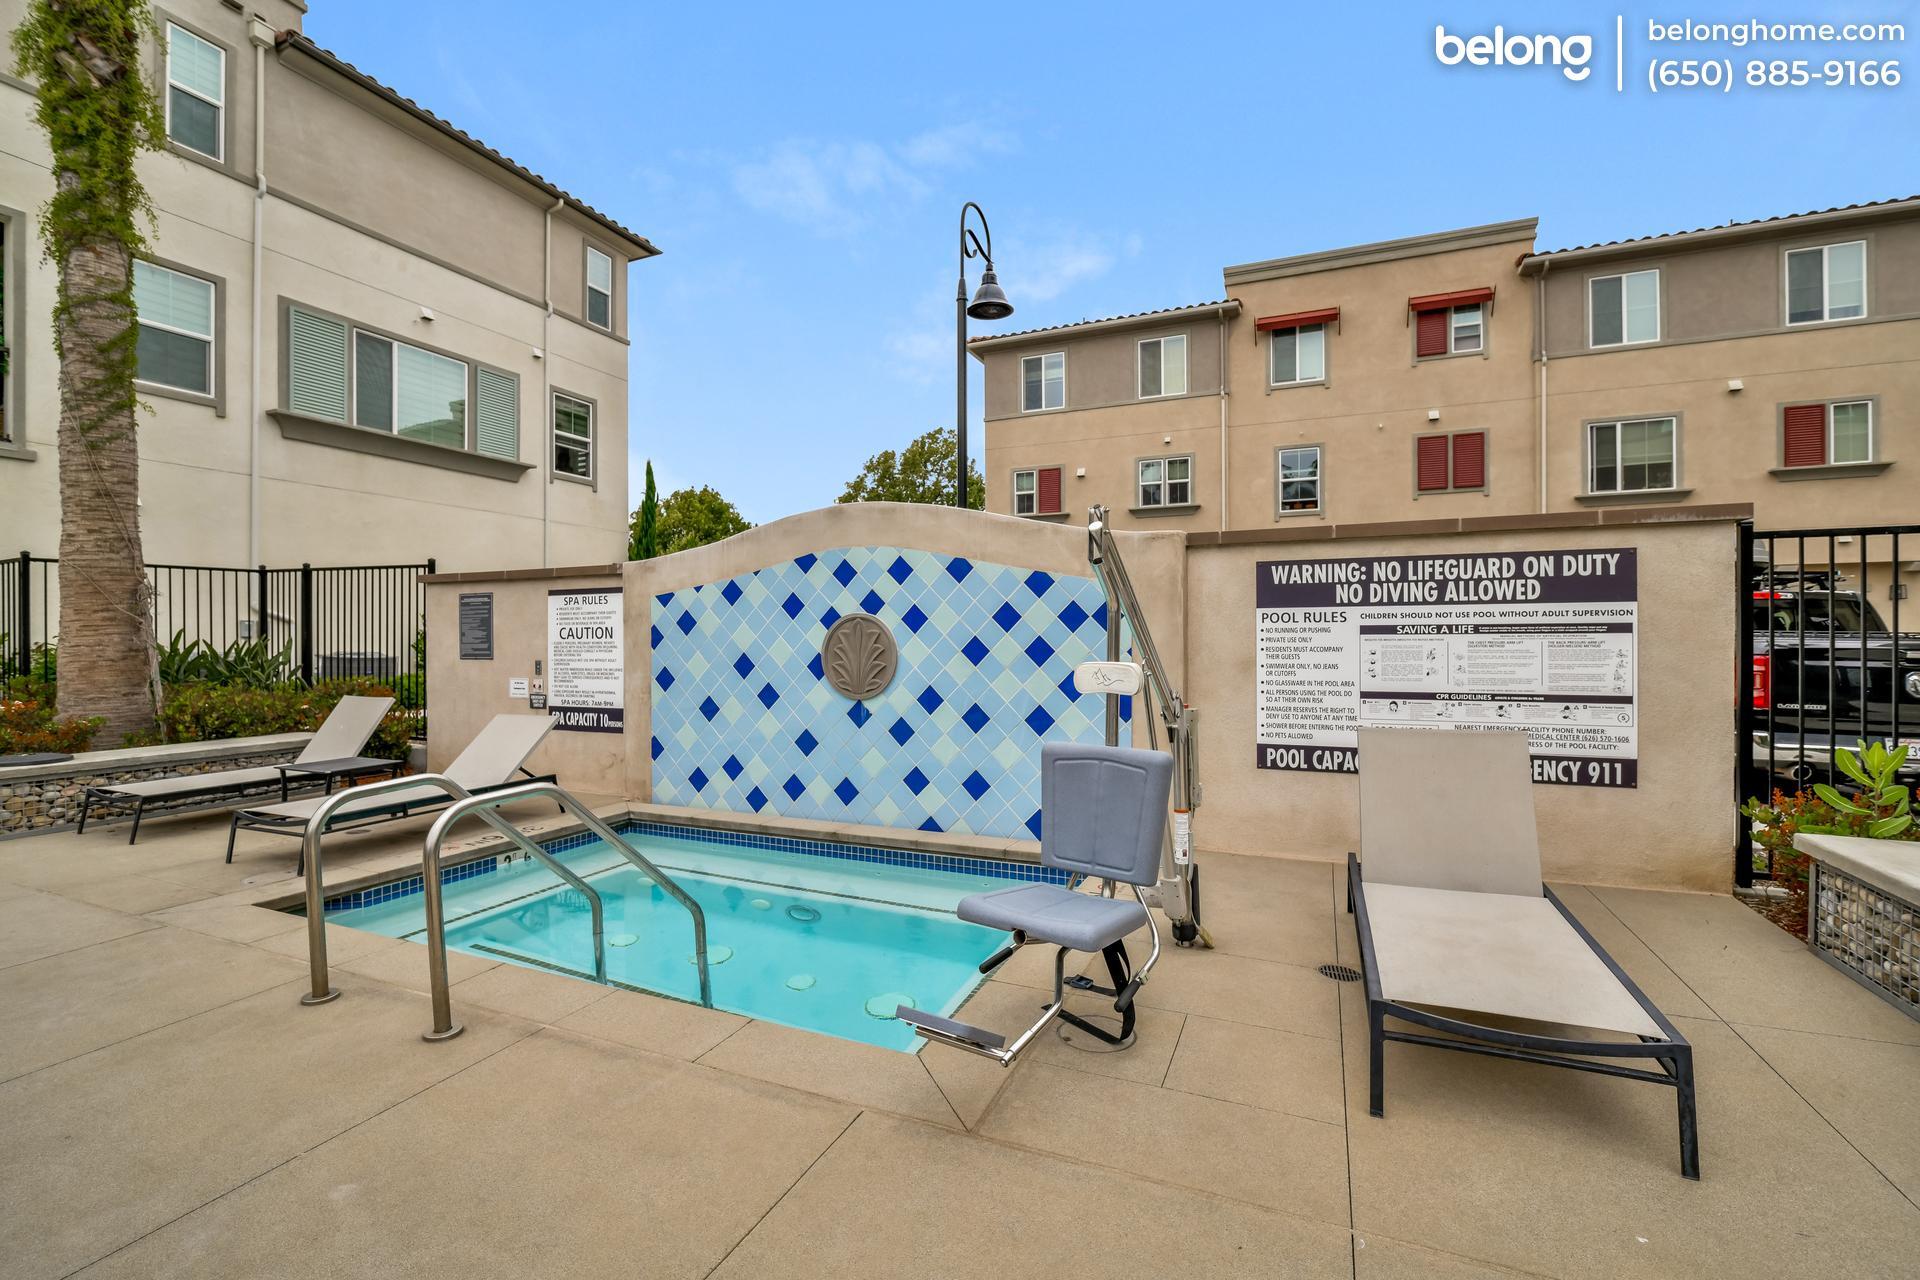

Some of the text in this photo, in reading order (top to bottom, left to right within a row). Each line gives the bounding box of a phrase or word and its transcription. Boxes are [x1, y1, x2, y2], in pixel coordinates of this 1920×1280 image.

[1271, 553, 1620, 584] WARNING: NO LIFEGUARD ON DUTY
[1336, 578, 1541, 604] NO DIVING ALLOWED
[563, 595, 609, 606] SPA RULES
[1261, 611, 1347, 623] POOL RULES
[1435, 611, 1454, 619] NOT
[1499, 610, 1539, 618] WITHOUT
[1572, 609, 1634, 617] SUPERVISION
[559, 627, 613, 640] CAUTION
[1396, 625, 1437, 634] SAVING
[1440, 625, 1449, 634] A
[1452, 625, 1475, 634] LIFE
[566, 712, 598, 726] CAPACITY
[600, 713, 609, 728] 10
[1588, 743, 1620, 751] FACILITY:
[1266, 748, 1358, 771] POOL CAPA
[1530, 760, 1622, 784] ENCY 911
